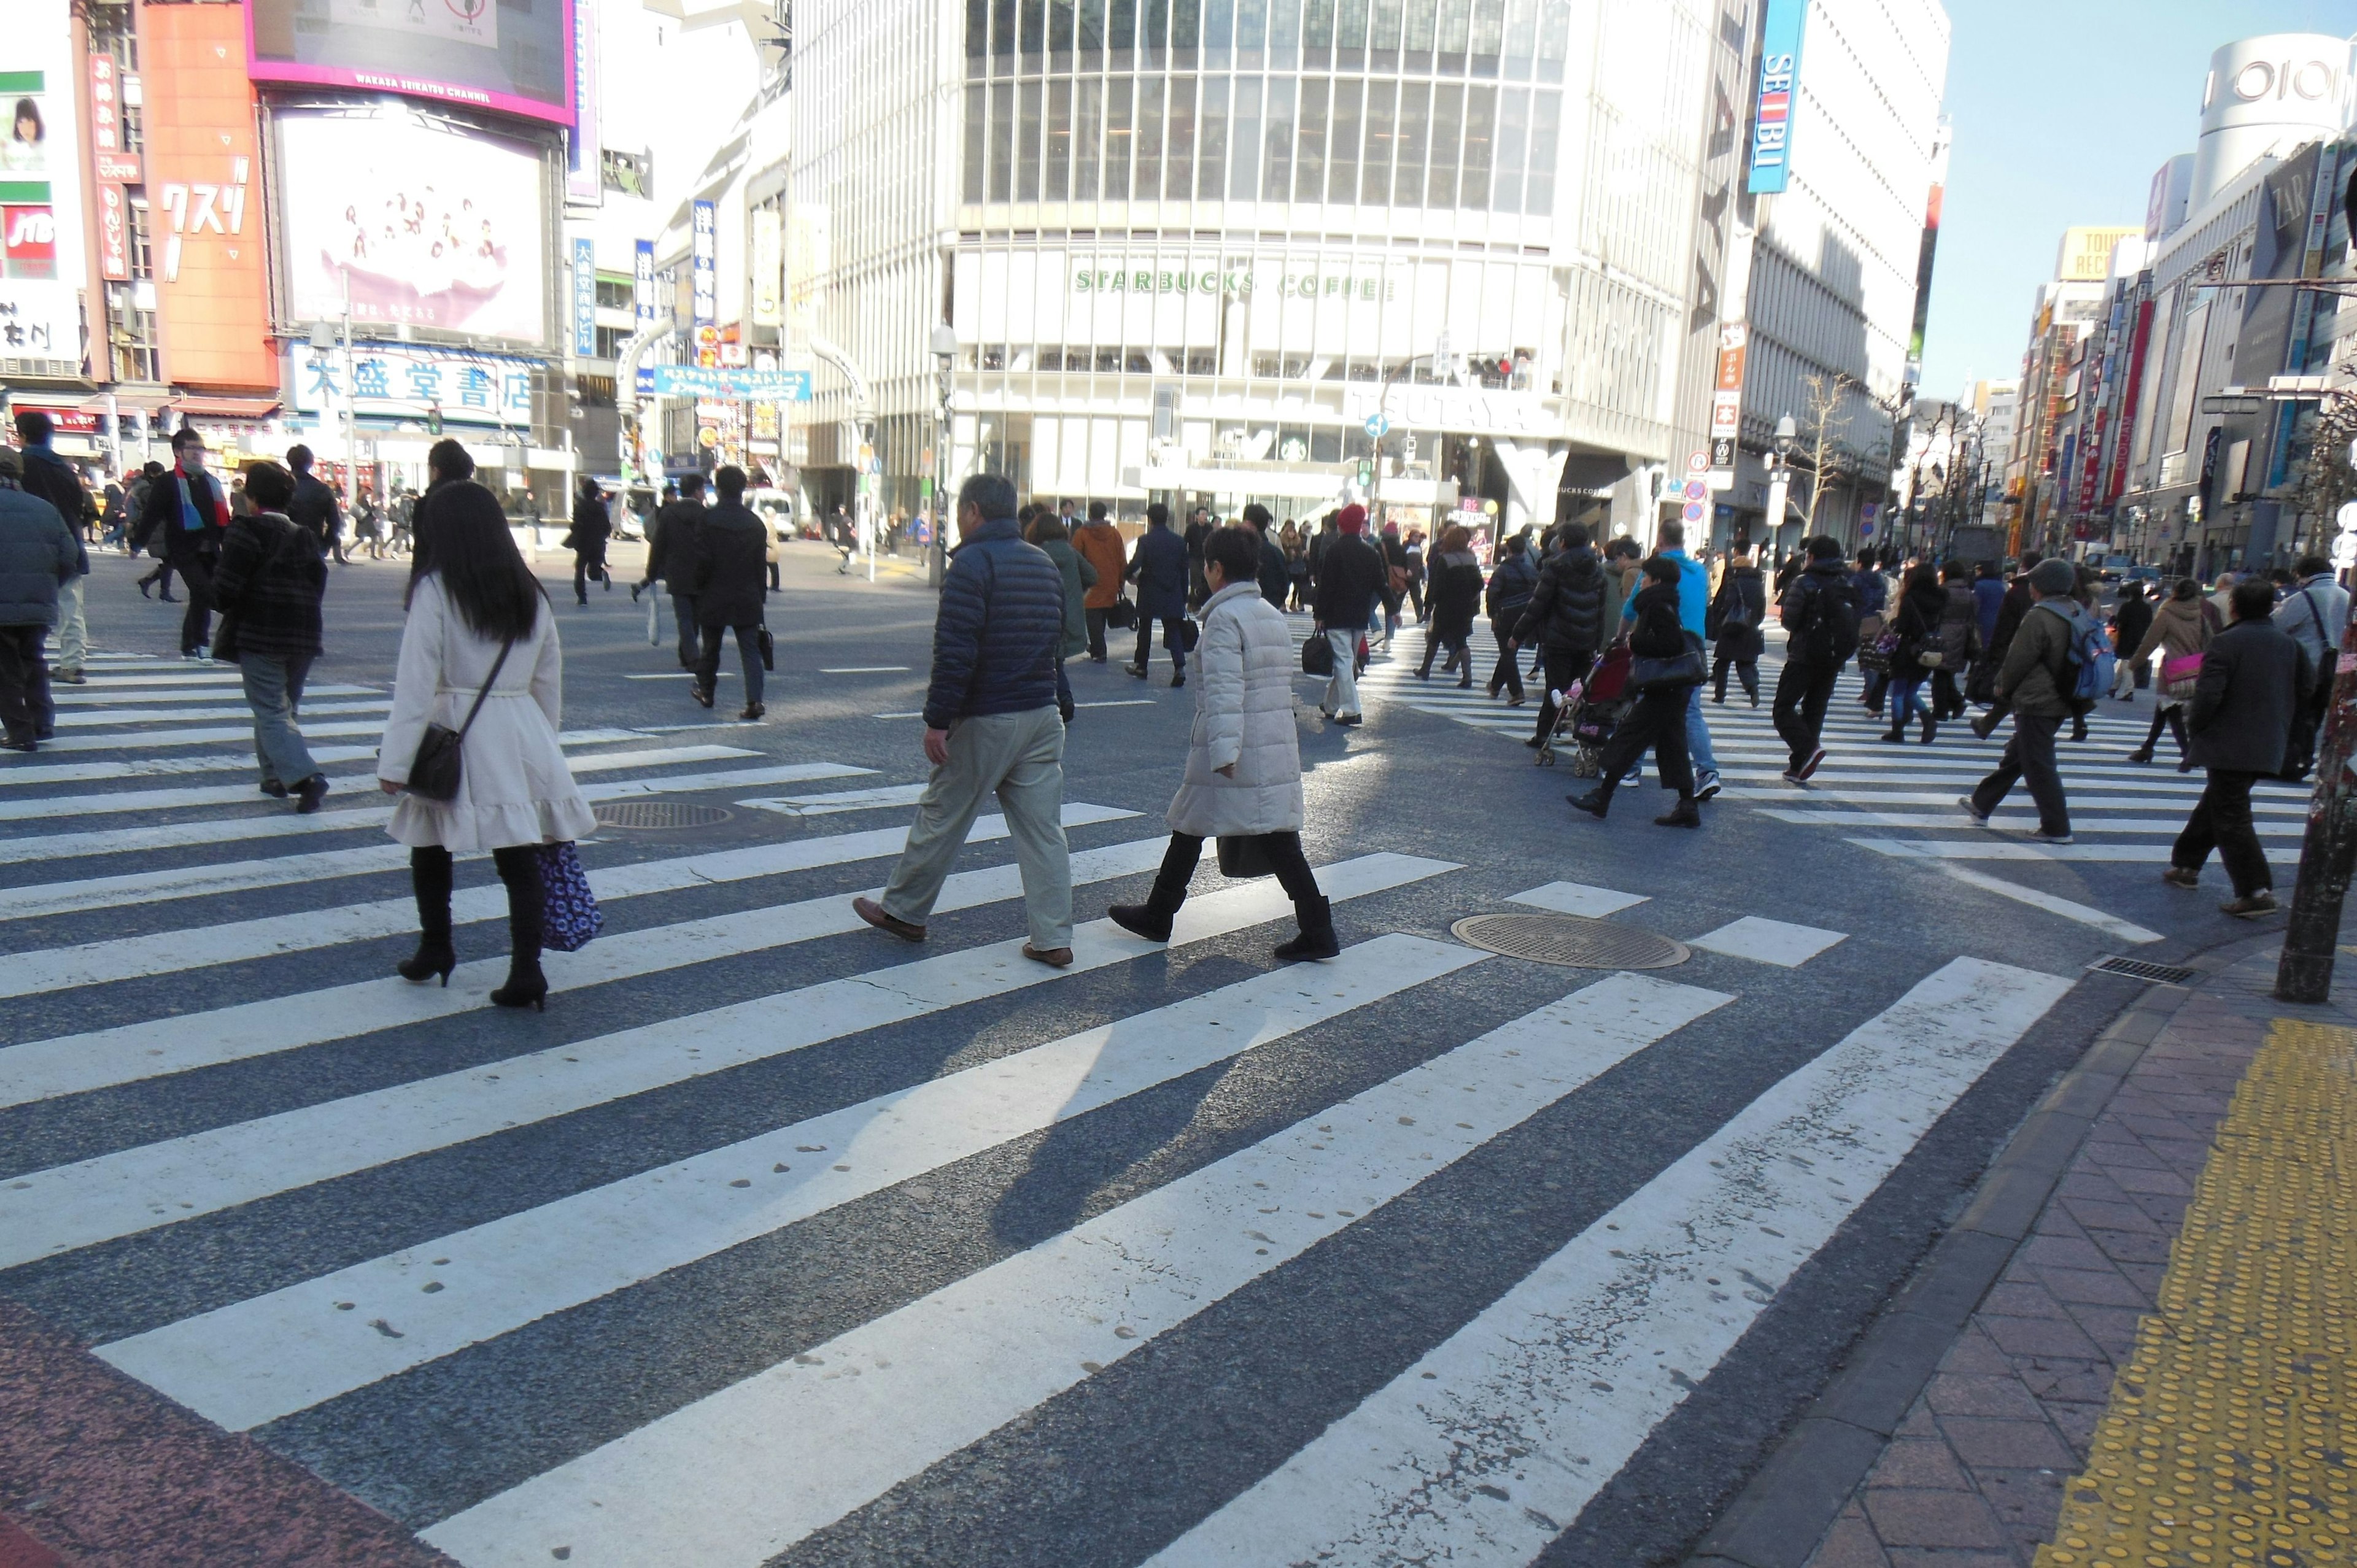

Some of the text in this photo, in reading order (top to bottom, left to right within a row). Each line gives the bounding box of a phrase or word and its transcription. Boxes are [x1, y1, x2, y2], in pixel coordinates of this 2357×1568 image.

[355, 74, 490, 104] WAKASA SEIKATSU CHANNEL
[1753, 54, 1792, 169] SEIBU
[1075, 269, 1395, 301] STARBUCKS COFFEE
[307, 358, 530, 409] 大盛堂書店
[1717, 406, 1735, 423] 本
